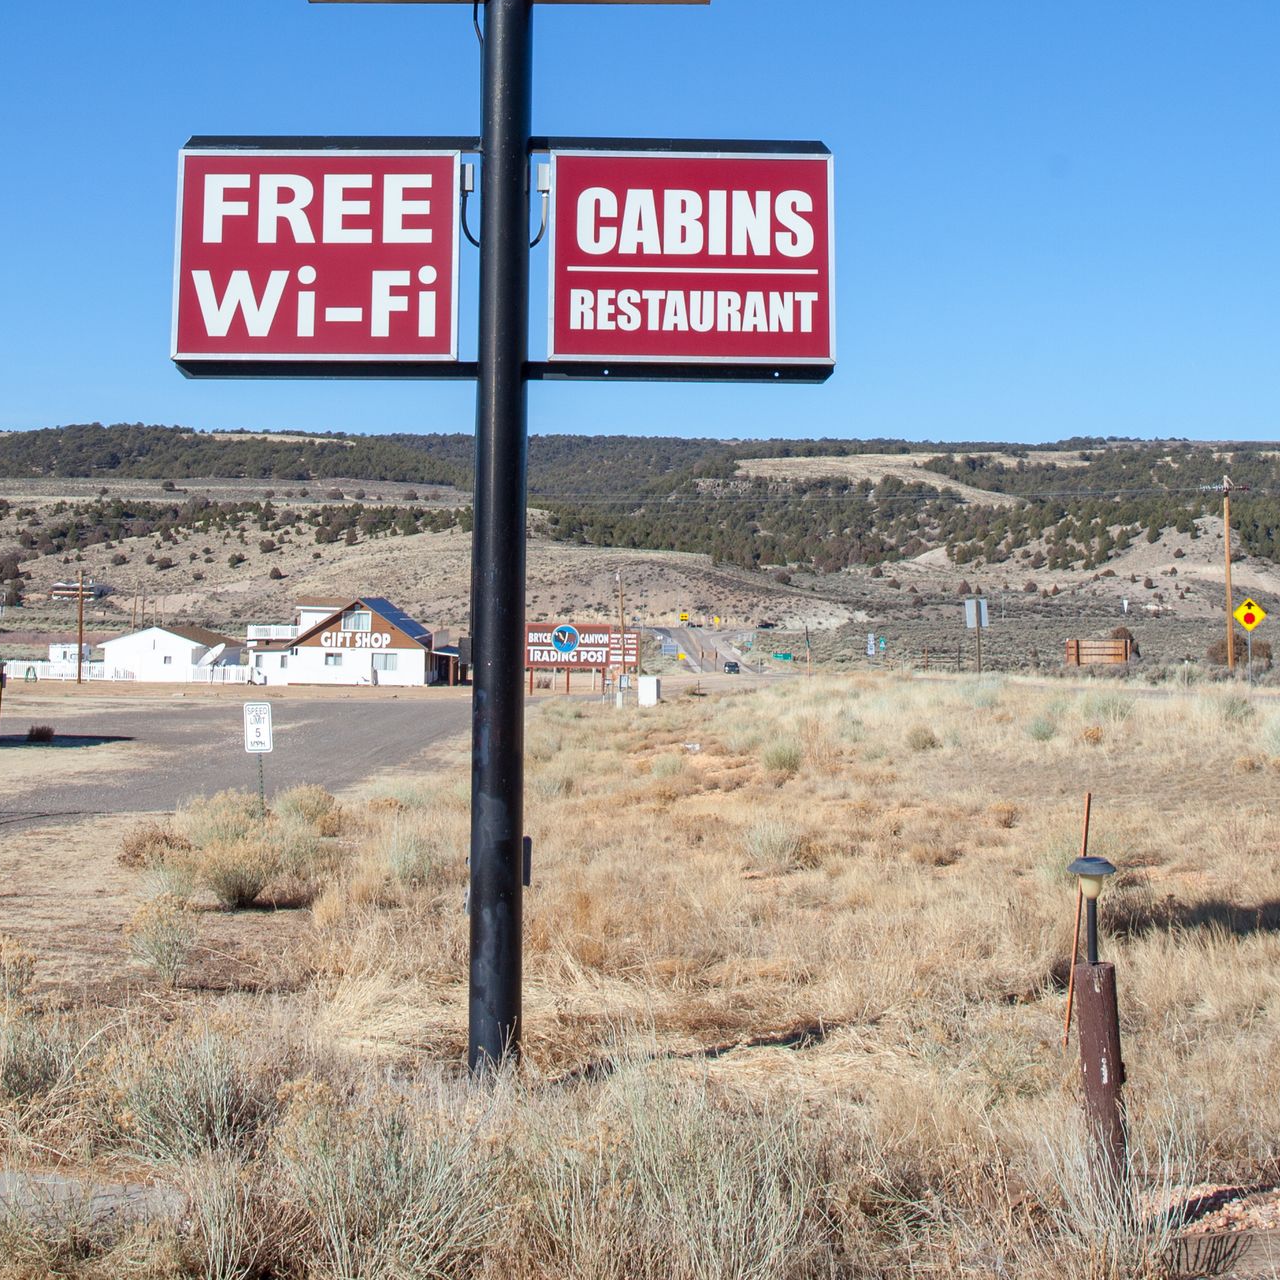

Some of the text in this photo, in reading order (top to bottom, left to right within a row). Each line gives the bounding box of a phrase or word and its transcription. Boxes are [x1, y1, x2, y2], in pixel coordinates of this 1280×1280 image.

[202, 173, 434, 245] FREE
[576, 186, 816, 258] CABINS
[191, 265, 439, 338] Wi-Fi
[569, 288, 819, 333] RESTAURANT
[320, 631, 391, 649] GIFT SHOP
[528, 632, 609, 644] BRYCE CANYON
[528, 647, 607, 663] TRADING POST
[247, 707, 267, 715] SPEED
[255, 728, 261, 738] 5
